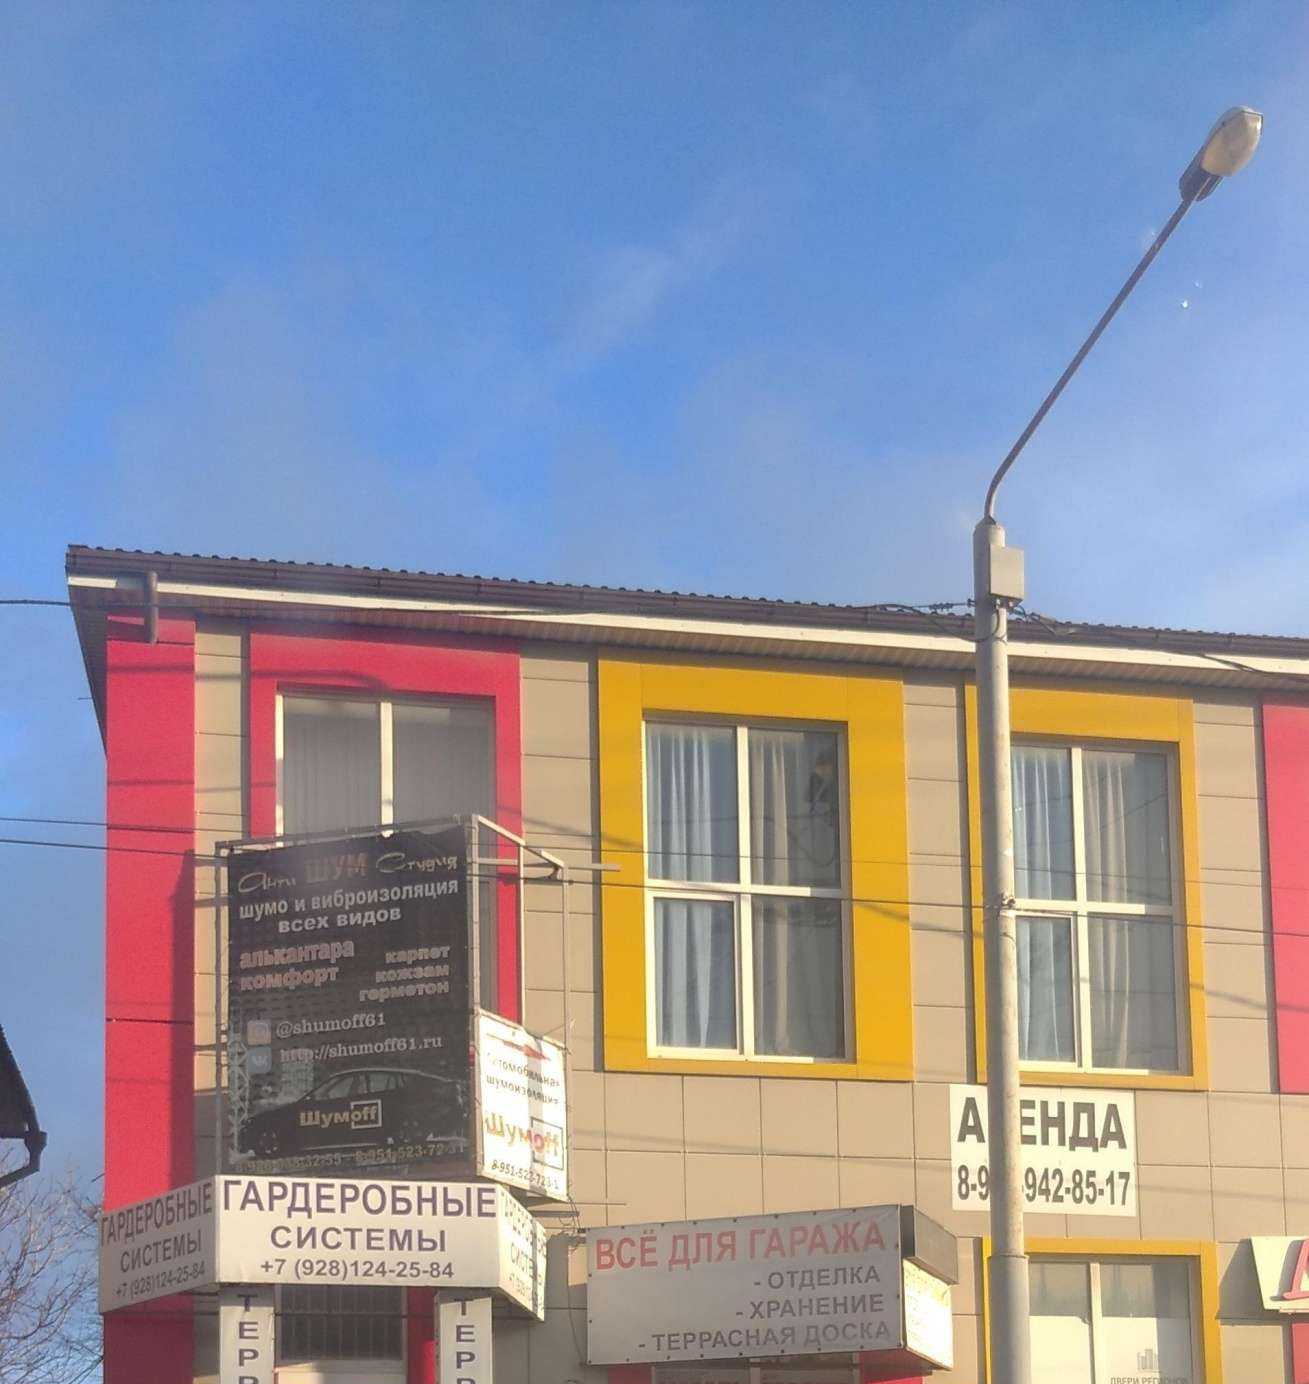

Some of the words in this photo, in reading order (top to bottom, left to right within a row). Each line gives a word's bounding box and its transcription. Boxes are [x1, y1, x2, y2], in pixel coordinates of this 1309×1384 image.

[304, 852, 368, 884] ШУМ
[376, 852, 458, 873] Студия
[239, 900, 288, 921] шумо
[295, 898, 306, 912] и
[312, 879, 459, 913] виброизоляция
[278, 915, 329, 933] всех
[337, 907, 402, 928] видов
[239, 940, 355, 969] алькантара
[240, 966, 339, 991] комфорт
[375, 965, 450, 983] кожзам
[276, 1012, 386, 1039] @shumoff61
[957, 1097, 1127, 1152] АЕНДА
[222, 1180, 497, 1219] ГАРДЕРОБНЫЕ
[957, 1164, 1130, 1206] 8-9942-85-17
[101, 1182, 212, 1246] ГАРДЕРОБНЫЕ
[120, 1229, 201, 1273] СИСТЕМЫ
[270, 1226, 446, 1252] СИСТЕМЫ
[595, 1229, 658, 1271] ВСЁ
[668, 1230, 736, 1272] ДЛЯ
[750, 1219, 885, 1259] ГАРАЖА
[261, 1259, 286, 1275] +7
[294, 1258, 455, 1281] (928)124-25-84
[768, 1265, 880, 1291] ОТДЕЛКА
[750, 1294, 884, 1320] ХРАНЕНИЕ
[652, 1327, 796, 1352] ТЕРРАСНАЯ
[804, 1320, 890, 1347] ДОСКА
